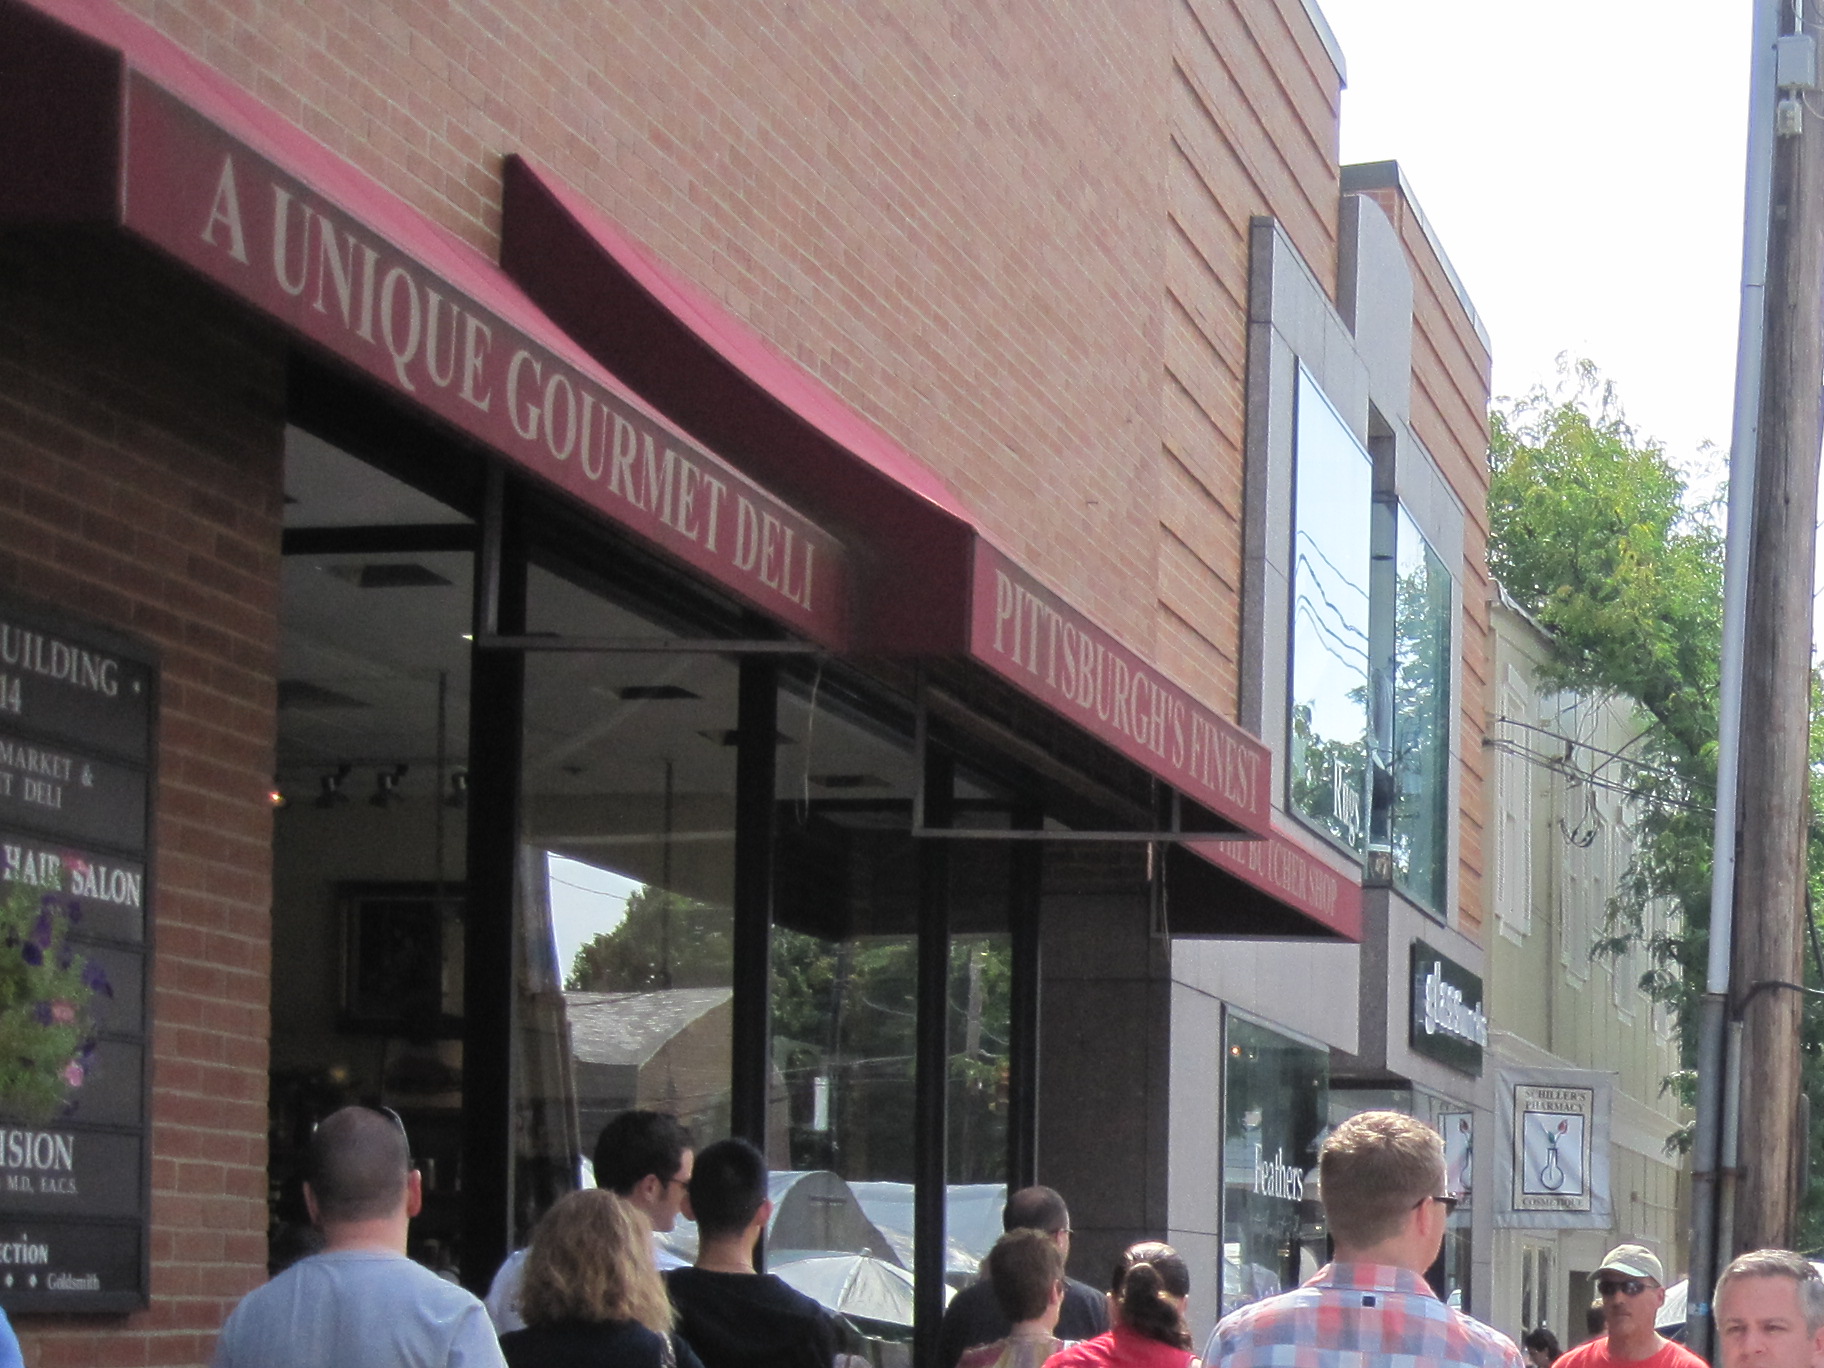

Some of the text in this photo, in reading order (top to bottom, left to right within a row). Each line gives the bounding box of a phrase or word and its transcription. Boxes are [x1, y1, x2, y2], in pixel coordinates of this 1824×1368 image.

[201, 154, 814, 611] A UNIQUE GOURMET DELI
[993, 568, 1261, 814] PITTSBURGH'S FINEST
[25, 778, 62, 809] DELI
[71, 864, 142, 907] SALON
[1525, 1101, 1584, 1113] PHARMACY
